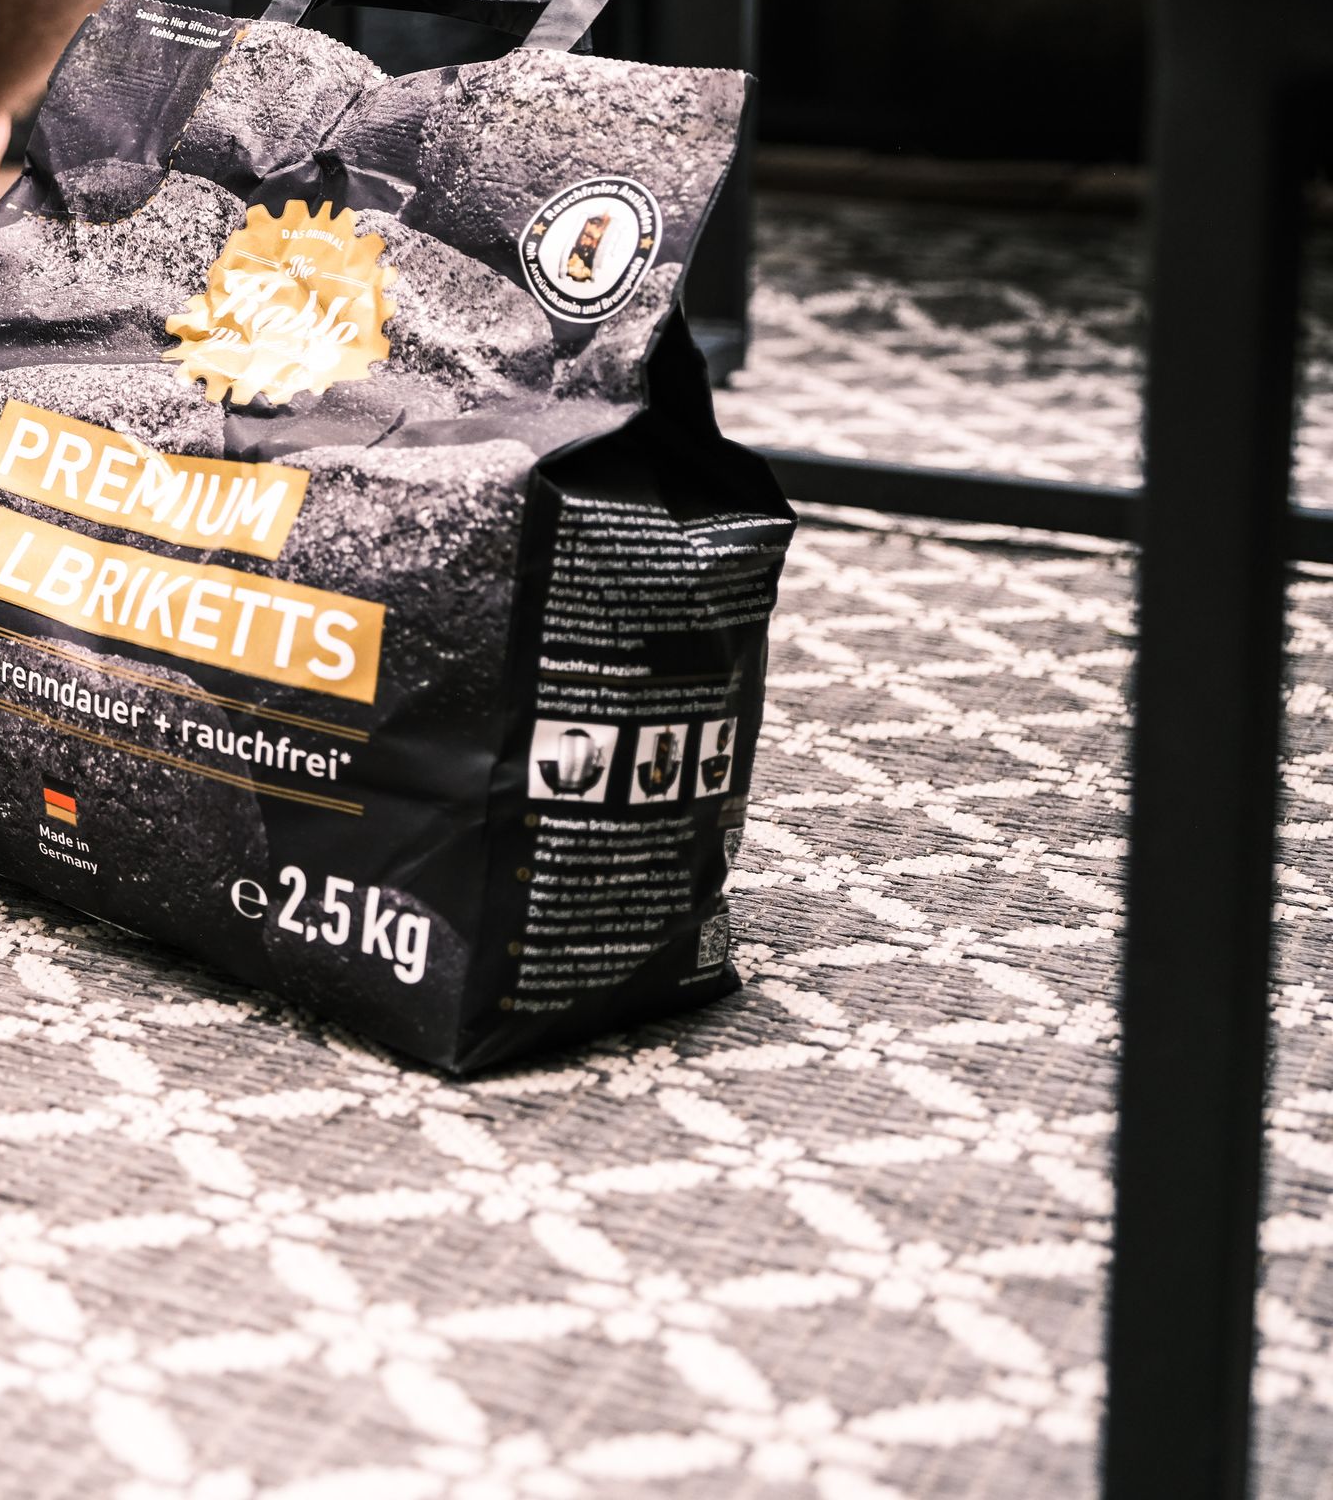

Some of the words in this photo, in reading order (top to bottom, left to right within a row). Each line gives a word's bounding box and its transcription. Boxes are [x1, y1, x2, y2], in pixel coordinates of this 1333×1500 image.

[135, 8, 169, 25] Sauber:
[170, 16, 188, 29] Hier
[189, 20, 217, 36] öffnen
[150, 26, 175, 40] Kohle
[543, 182, 619, 222] Rauchfreies
[618, 185, 653, 234] Anzünden
[281, 229, 305, 240] DAS
[306, 228, 345, 251] ORIGINAL
[526, 241, 537, 260] mit
[285, 254, 317, 280] Die
[529, 263, 582, 314] Anzündkamin
[601, 257, 645, 310] Brennpaste
[582, 302, 601, 314] und
[608, 528, 641, 539] Premium
[575, 542, 614, 553] Stunden
[615, 543, 658, 554] Brenndauer
[553, 557, 571, 567] die
[552, 571, 569, 582] Als
[573, 575, 615, 587] einziges
[549, 587, 583, 599] Kohle
[586, 590, 599, 599] zu
[545, 600, 606, 615] Abfallholz
[609, 607, 625, 616] und
[542, 632, 615, 647] geschlossen
[539, 656, 600, 674] Rauchfrei
[538, 684, 557, 695] Um
[561, 687, 598, 698] unsere
[536, 699, 587, 714] benötigst
[590, 704, 604, 714] du
[540, 816, 588, 830] Premium
[589, 820, 641, 831] Grillbriketts
[39, 823, 74, 851] Made
[76, 837, 91, 853] in
[38, 840, 99, 876] Germany
[534, 850, 551, 861] die
[529, 905, 543, 917] Du
[276, 865, 353, 948] 2,5
[361, 883, 431, 986] kg
[564, 944, 602, 956] Premium
